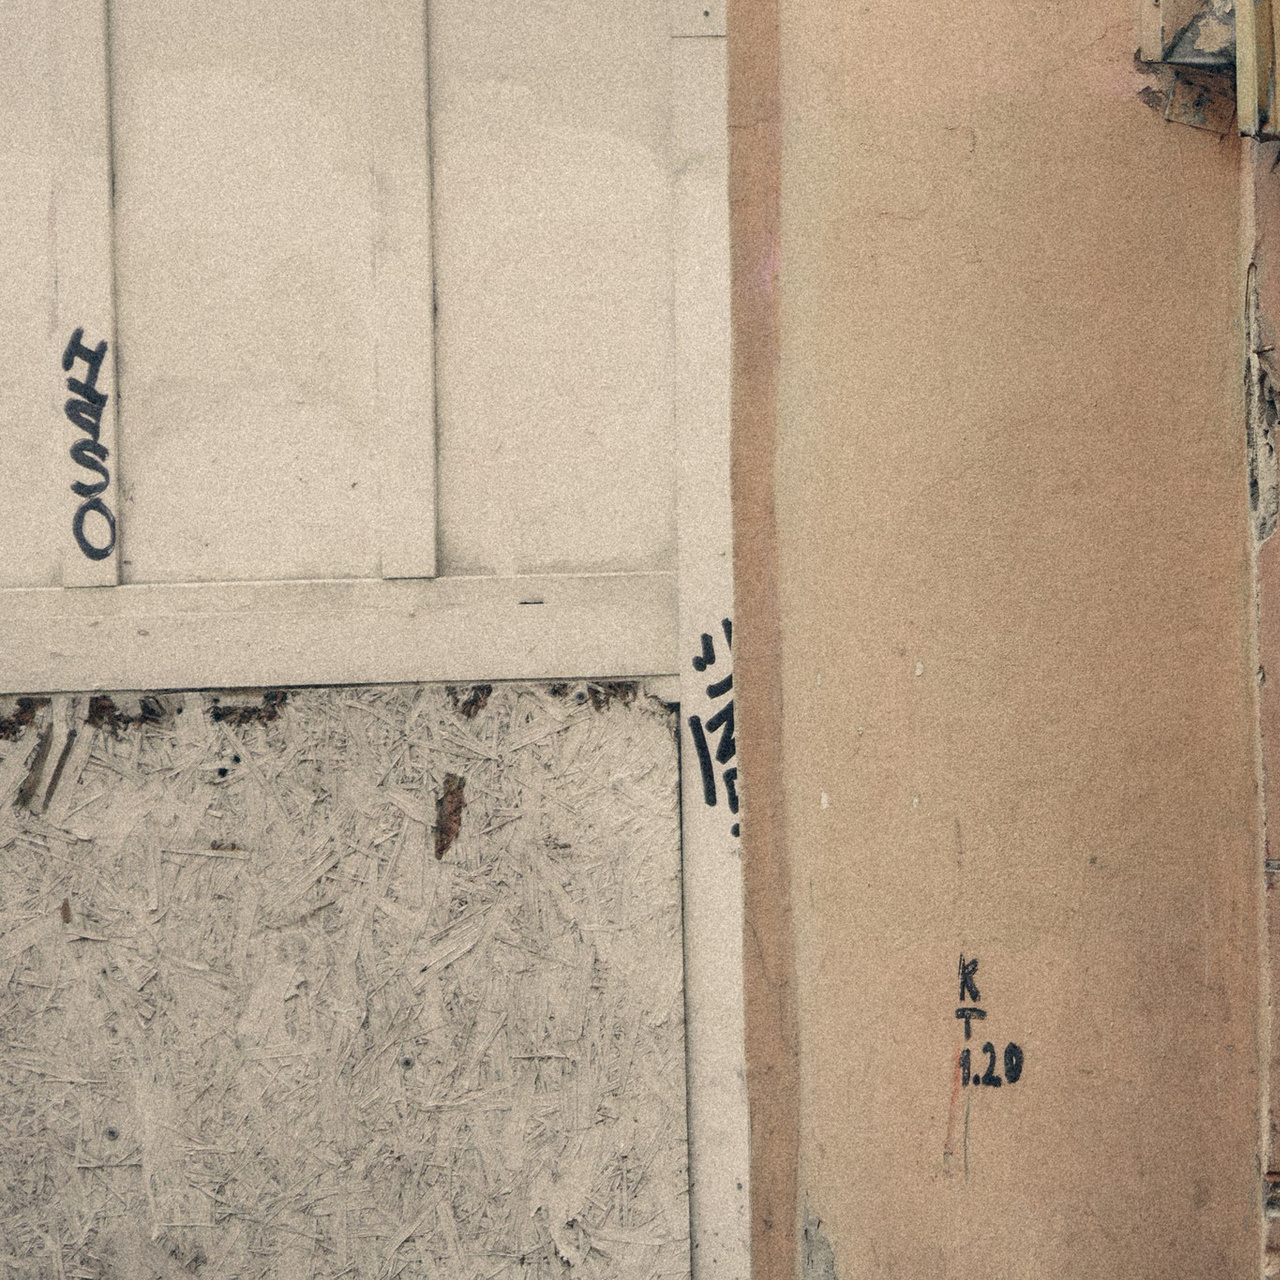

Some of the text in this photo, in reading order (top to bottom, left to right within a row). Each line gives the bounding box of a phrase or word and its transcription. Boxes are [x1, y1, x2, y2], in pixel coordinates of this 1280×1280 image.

[958, 953, 980, 1002] K
[955, 1007, 987, 1041] T
[960, 1042, 1024, 1087] 1.20
